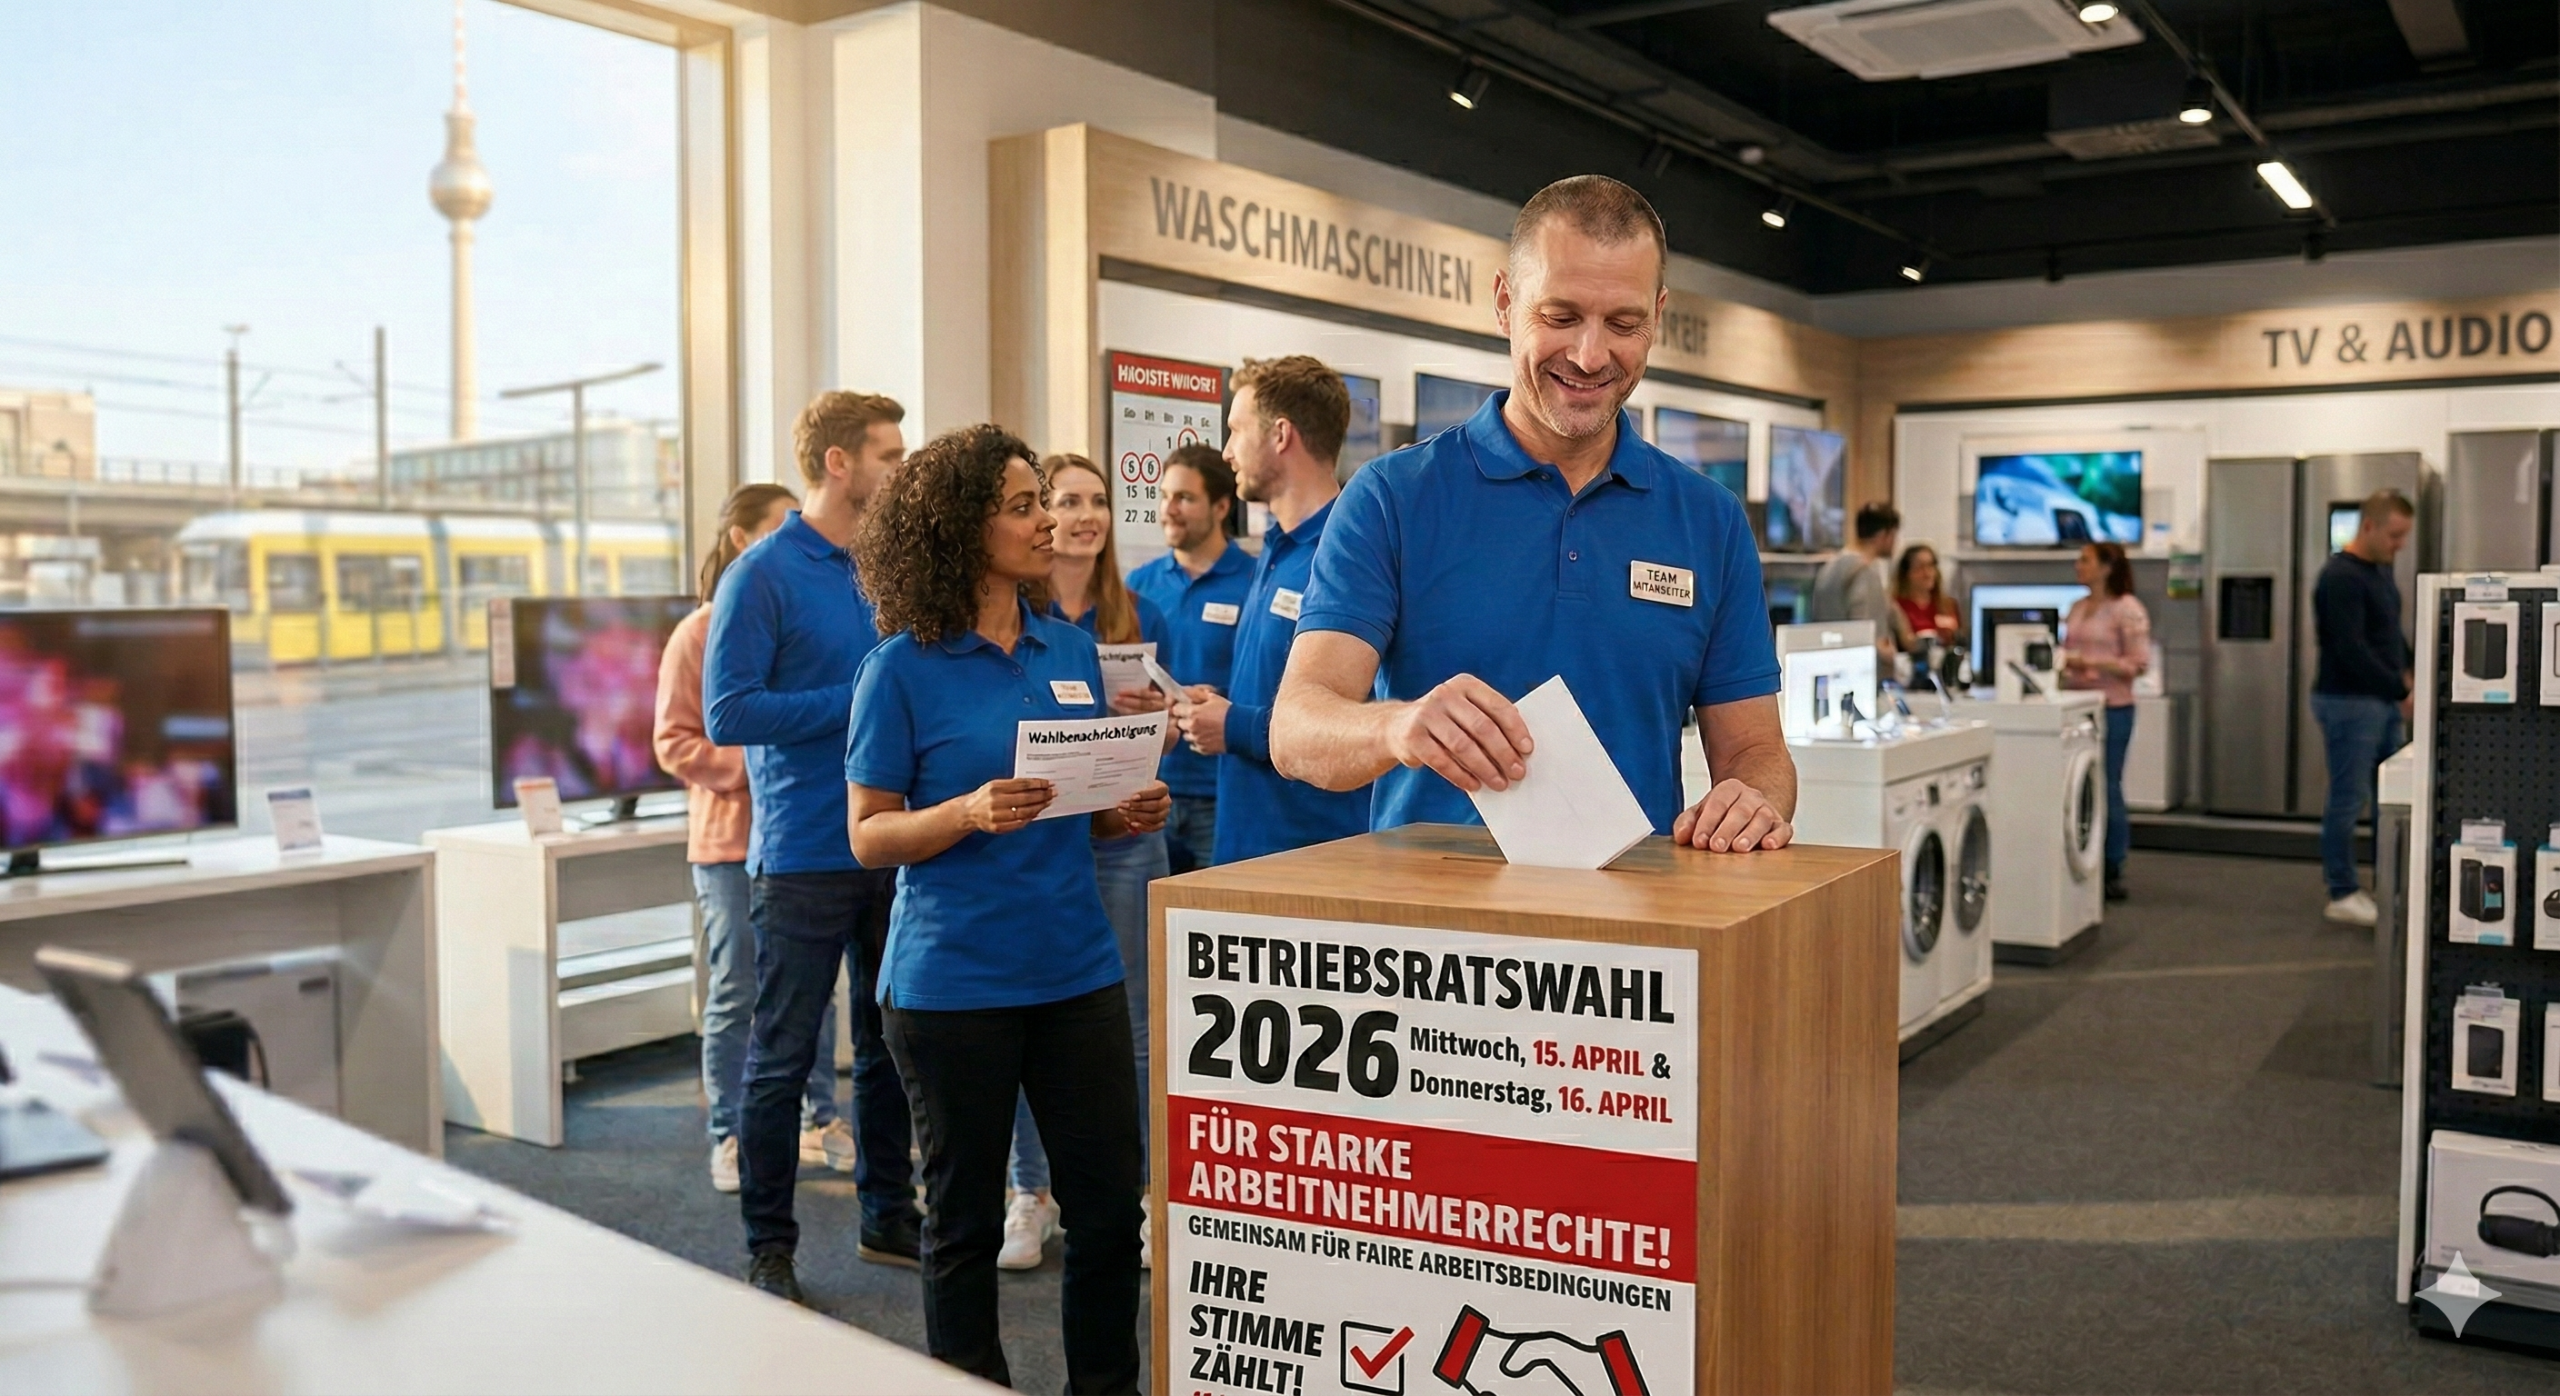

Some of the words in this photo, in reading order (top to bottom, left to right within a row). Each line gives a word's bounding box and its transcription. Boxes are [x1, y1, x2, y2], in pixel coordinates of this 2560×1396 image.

[1151, 177, 1473, 304] WASCHMASCHINEN
[2262, 328, 2319, 368] TV
[2337, 324, 2367, 363] &
[2386, 311, 2553, 361] AUDIO
[1124, 509, 1138, 523] 27
[1143, 510, 1156, 524] 28
[1125, 485, 1138, 499] 15
[1646, 569, 1678, 585] TEAM
[1188, 931, 1675, 1024] BETRIEBSRATSWAHL
[1188, 993, 1399, 1099] 2026
[1410, 1026, 1526, 1068] Mittwoch,
[1533, 1040, 1566, 1068] 15.
[1572, 1044, 1644, 1076] APRIL
[1651, 1052, 1671, 1080] &
[1410, 1068, 1553, 1114] Donnerstag,
[1558, 1086, 1592, 1113] 16.
[1598, 1091, 1672, 1123] APRIL
[1188, 1106, 1257, 1158] FÜR
[1268, 1124, 1412, 1181] STARKE
[1188, 1160, 1671, 1270] ARBEITNEHMERRECHTE!
[1188, 1214, 1306, 1253] GEMEINSAM
[1311, 1230, 1351, 1260] FÜR
[1356, 1241, 1414, 1271] FAIRE
[1418, 1251, 1671, 1312] ARBEITSBEDINGUNGEN
[1189, 1260, 1268, 1304] IHRE
[1188, 1303, 1325, 1358] STIMME
[1189, 1342, 1304, 1396] ZÄHLT!
